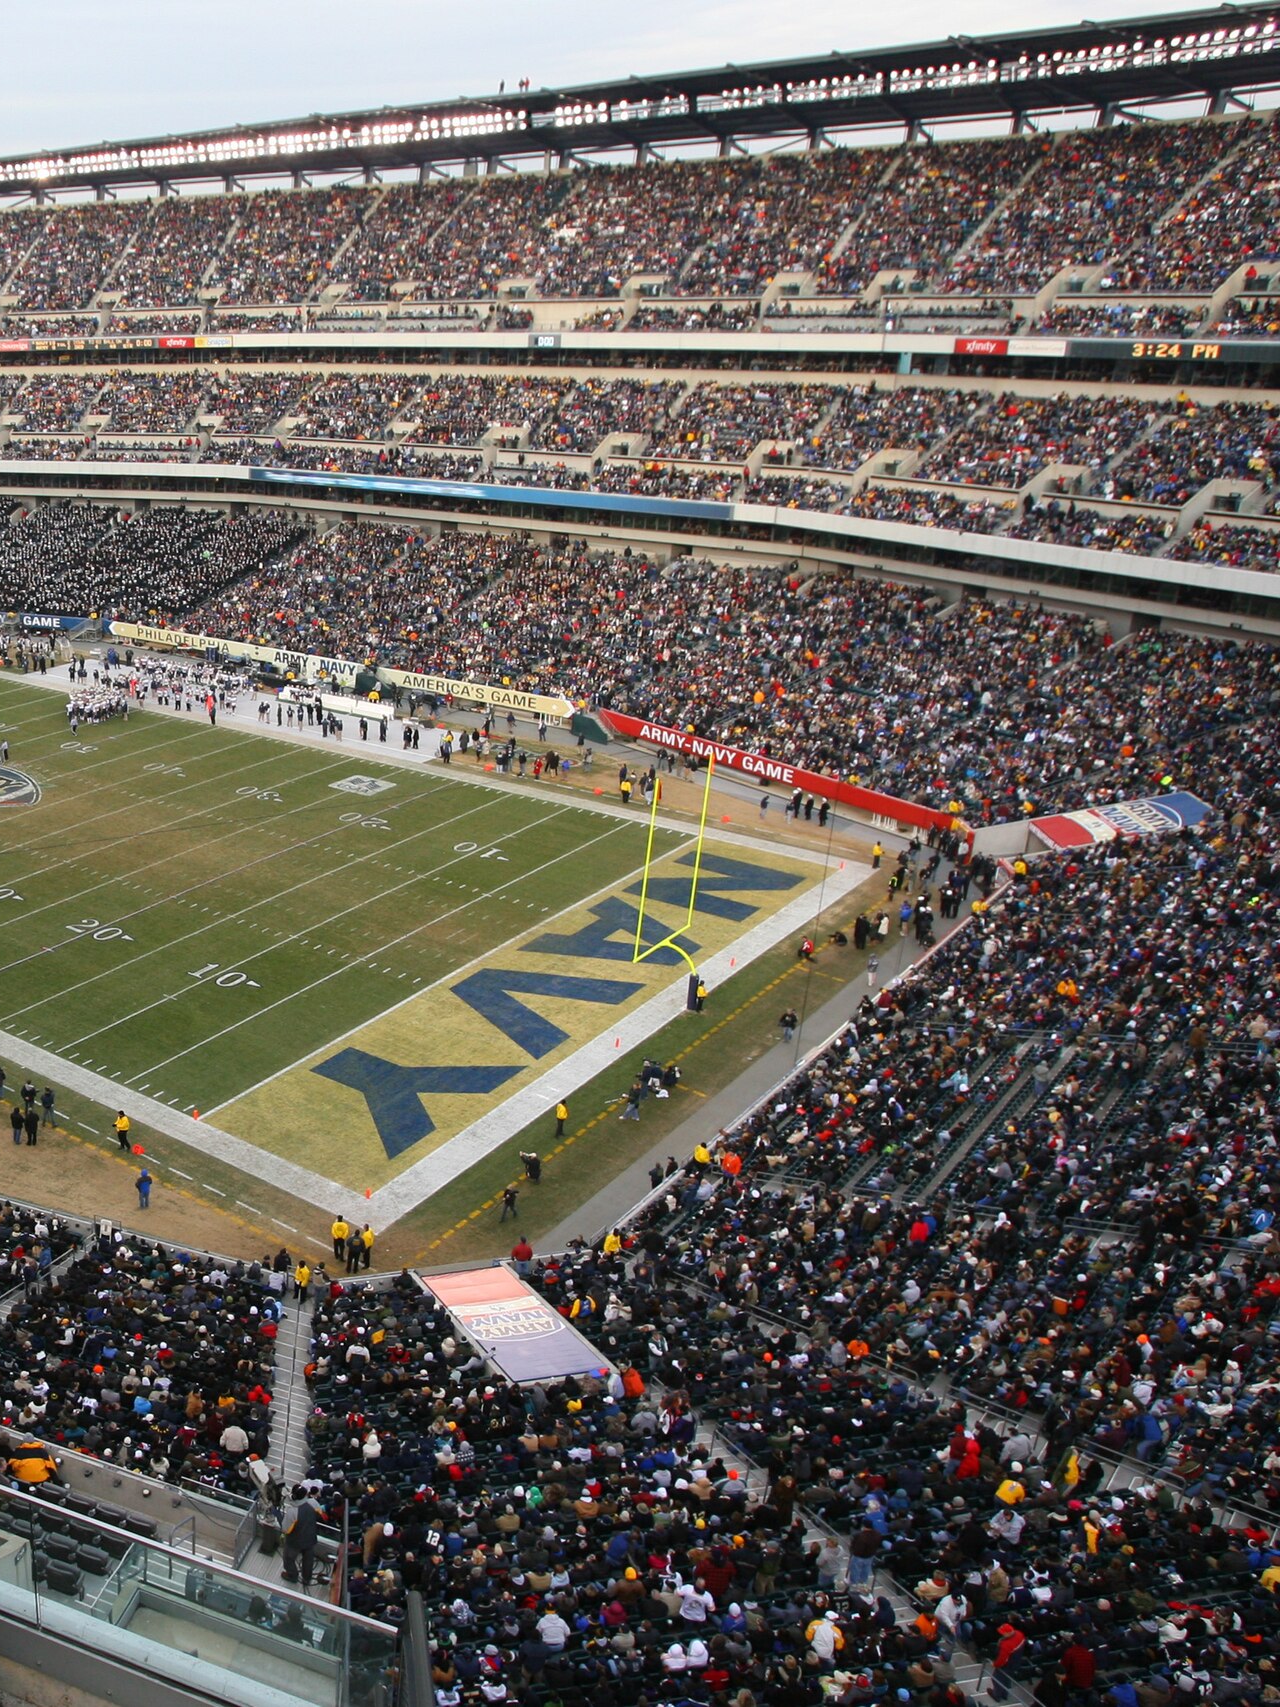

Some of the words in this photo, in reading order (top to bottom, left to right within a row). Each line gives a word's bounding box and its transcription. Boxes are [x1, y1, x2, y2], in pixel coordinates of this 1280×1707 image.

[166, 339, 187, 347] xfinity
[966, 340, 997, 353] xfinity
[1131, 343, 1180, 358] 3:24
[1192, 345, 1220, 359] PM
[23, 615, 61, 627] GAME
[136, 628, 230, 653] PHILADELPHIA
[274, 651, 309, 668] ARMY
[320, 659, 357, 677] NAVY
[402, 675, 485, 700] AMERICA'S
[491, 690, 538, 709] GAME
[639, 723, 738, 766] ARMY-NAVY
[741, 756, 795, 785] GAME
[235, 785, 279, 803] 30
[338, 811, 387, 830] 20
[1098, 805, 1149, 836] NAVY
[1127, 801, 1171, 830] ARMY
[452, 841, 502, 861] 10
[65, 917, 123, 942] 20
[187, 962, 248, 988] 10
[309, 850, 807, 1161] NAVY
[471, 1309, 551, 1327] NAVY
[482, 1318, 556, 1339] ARMY
[425, 1529, 440, 1547] 12
